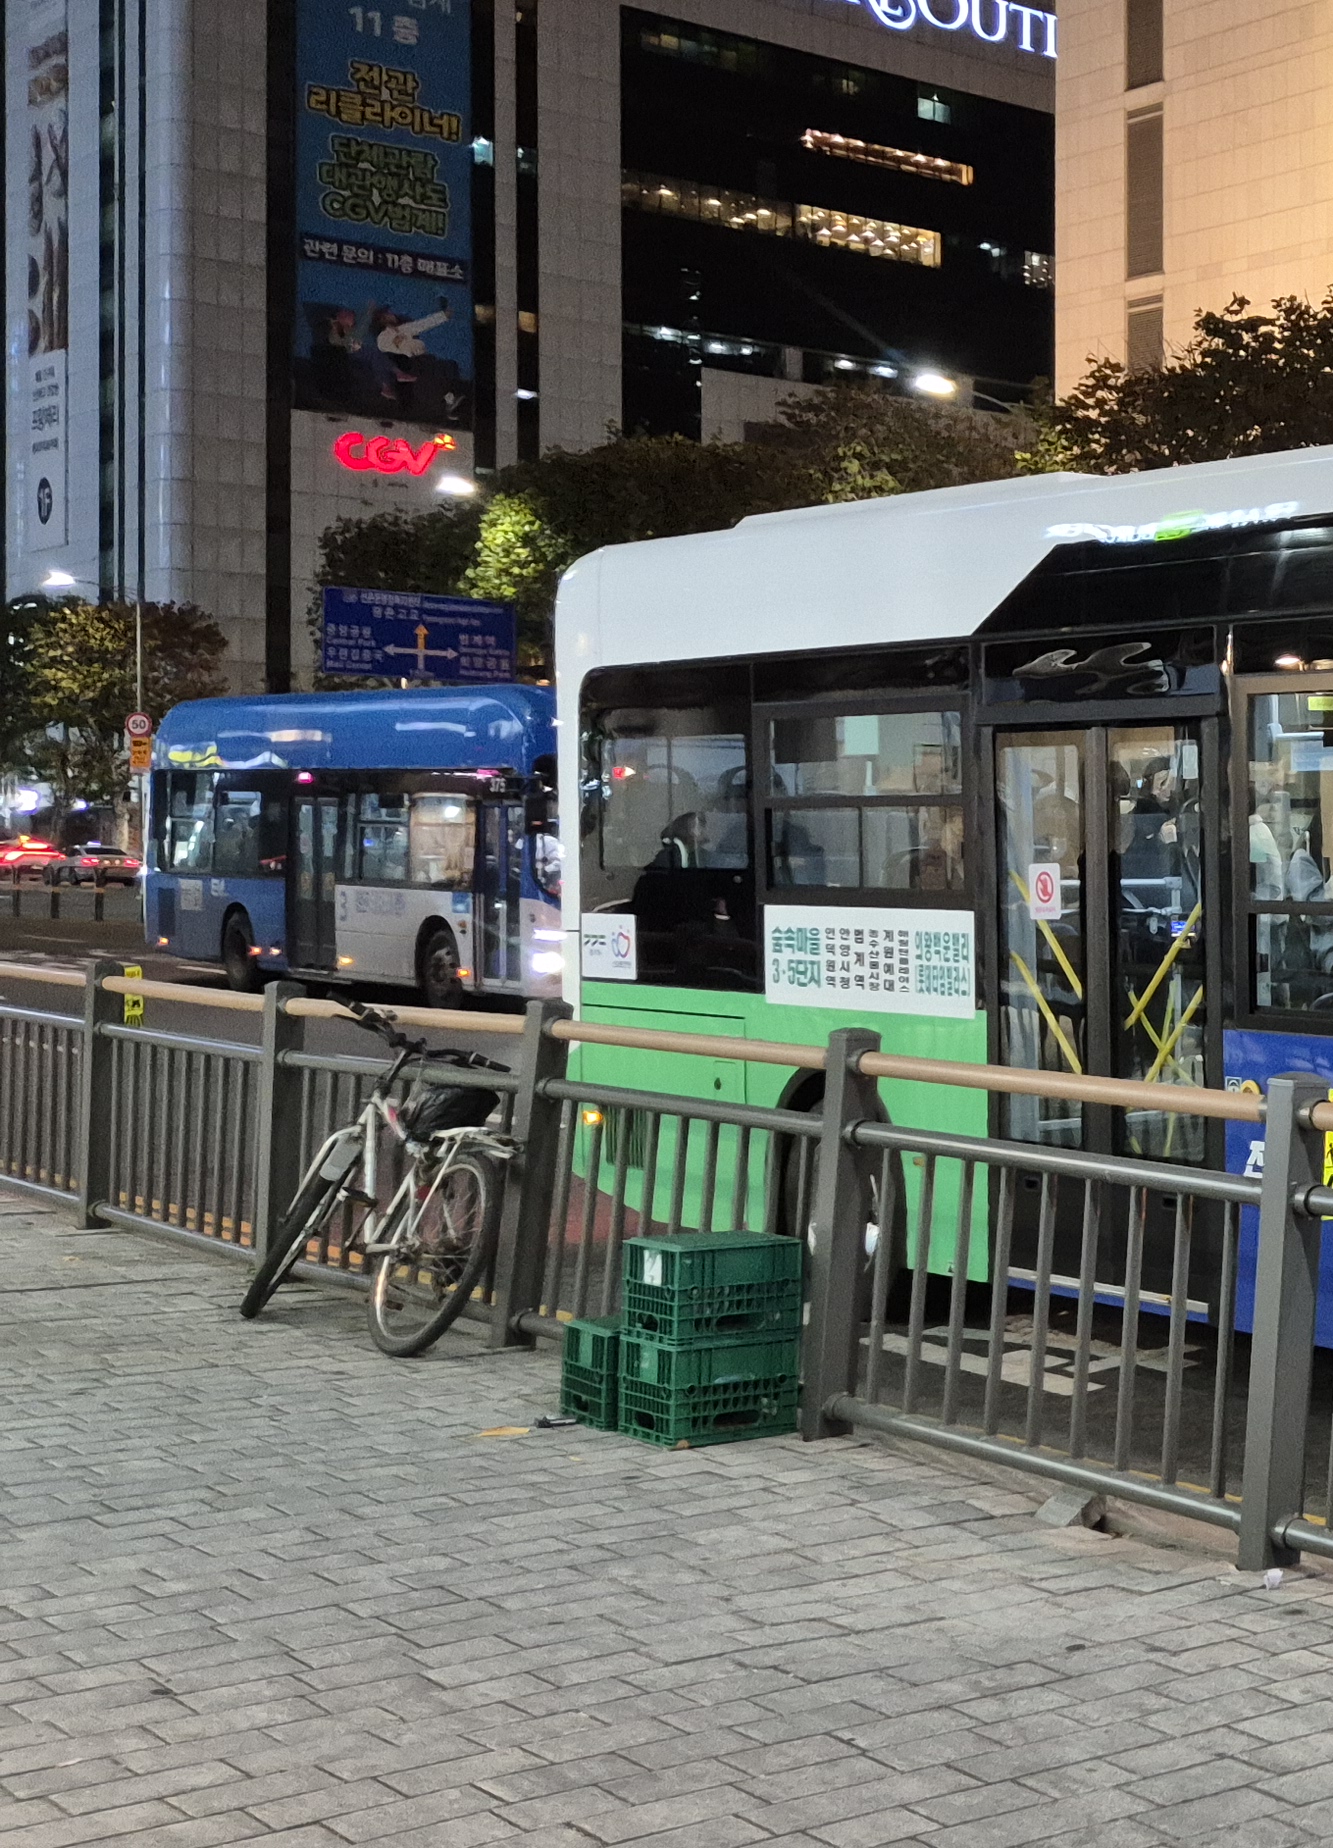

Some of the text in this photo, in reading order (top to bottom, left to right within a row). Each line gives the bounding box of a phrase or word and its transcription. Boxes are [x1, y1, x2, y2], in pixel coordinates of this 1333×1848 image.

[350, 7, 382, 37] 11
[349, 59, 420, 104] 전관
[306, 84, 462, 142] 리클라이너!
[303, 238, 338, 260] 관련
[341, 244, 374, 265] 문의
[334, 431, 438, 476] CGV
[131, 719, 146, 730] 50
[772, 926, 821, 956] 숲속마을
[825, 927, 837, 988] 인덕원역
[839, 927, 851, 990] 안양시청
[854, 928, 866, 990] 범계역
[883, 929, 896, 993] 계원예대
